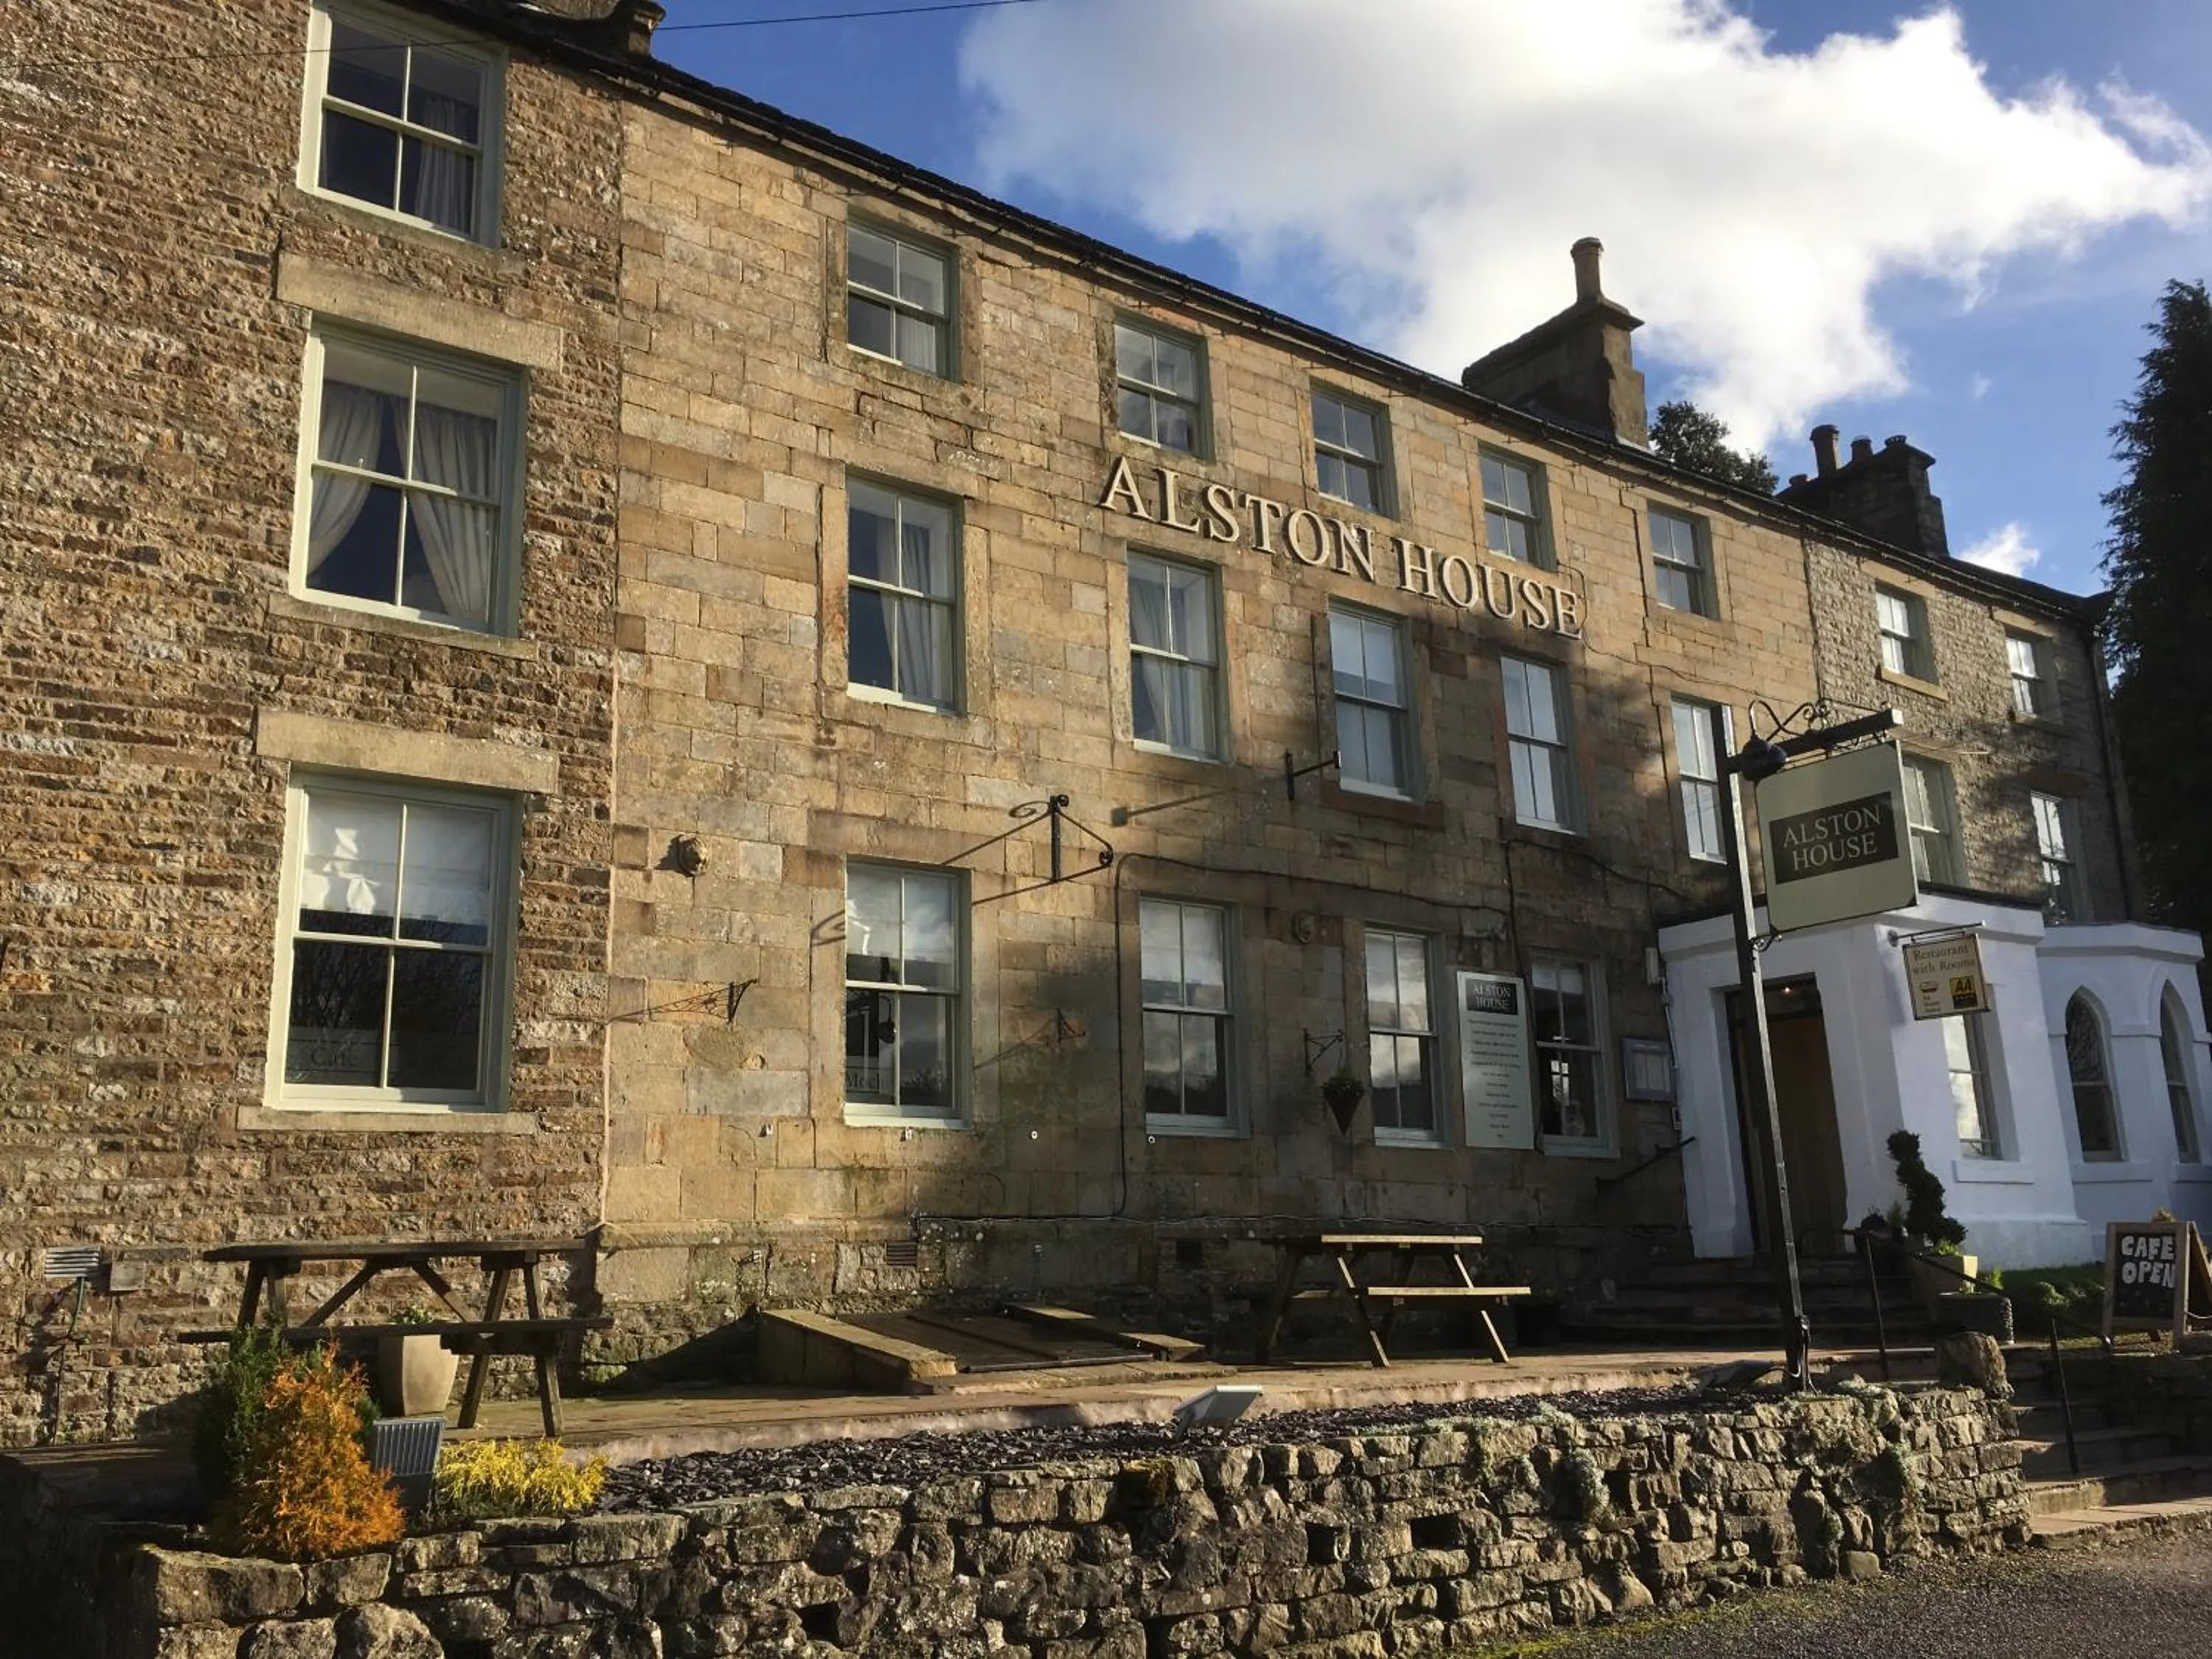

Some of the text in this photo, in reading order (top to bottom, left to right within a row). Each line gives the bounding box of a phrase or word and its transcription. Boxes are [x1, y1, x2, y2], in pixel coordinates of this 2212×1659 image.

[1101, 456, 1582, 640] ALSTON HOUSE
[1783, 805, 1881, 848] ALSTON
[1792, 833, 1878, 872] HOUSE
[1472, 983, 1511, 998] ALSTON
[1955, 978, 1973, 992] AA
[1475, 995, 1510, 1010] HOUSE
[2121, 1235, 2174, 1260] CAFE
[2121, 1261, 2175, 1288] OPEN
